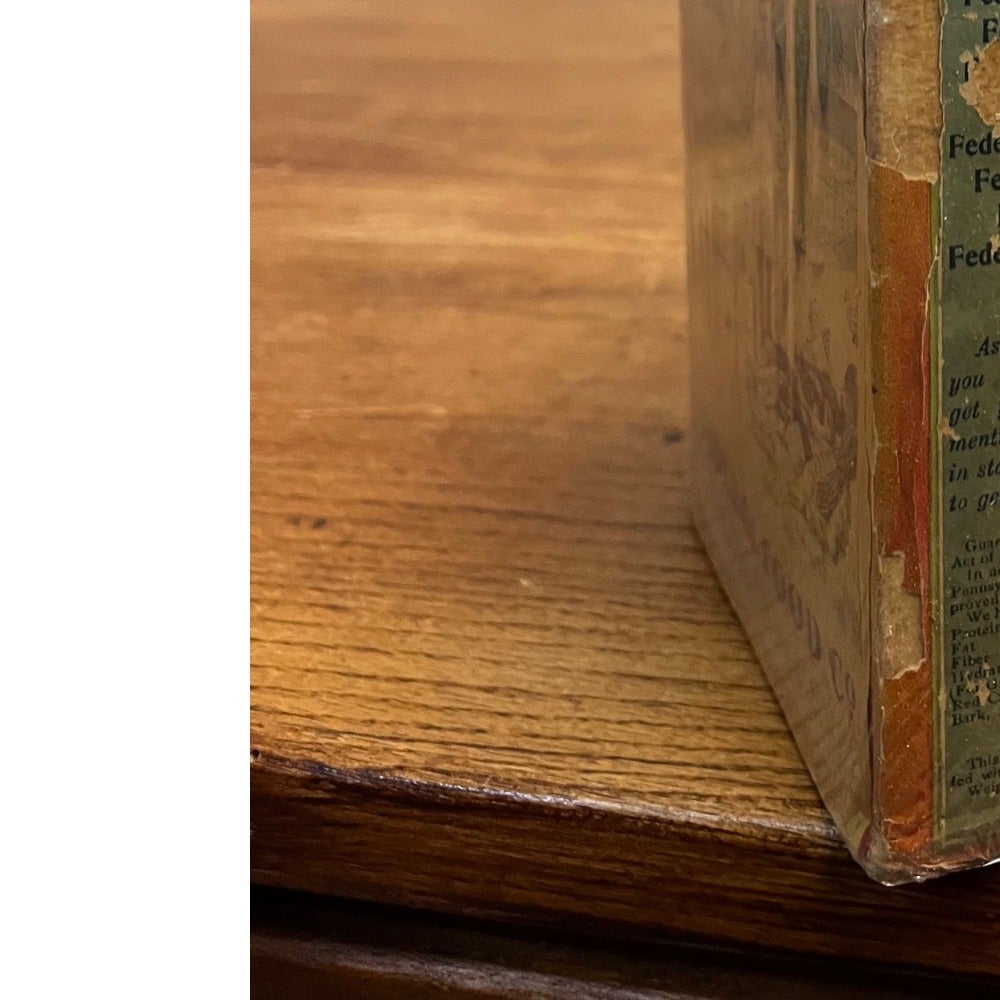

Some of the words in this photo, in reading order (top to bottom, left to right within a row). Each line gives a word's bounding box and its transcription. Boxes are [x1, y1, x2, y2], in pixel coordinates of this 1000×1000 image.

[949, 373, 985, 397] you
[949, 401, 980, 427] get
[949, 462, 968, 483] in
[949, 494, 968, 513] to
[951, 557, 976, 570] Act
[980, 552, 995, 565] of
[967, 569, 984, 582] In
[950, 594, 999, 616] proved
[967, 609, 990, 623] We
[951, 641, 976, 656] Fat
[951, 653, 989, 670] Fiber
[951, 694, 981, 712] Red
[951, 708, 991, 727] Bark,
[967, 752, 1000, 770] This
